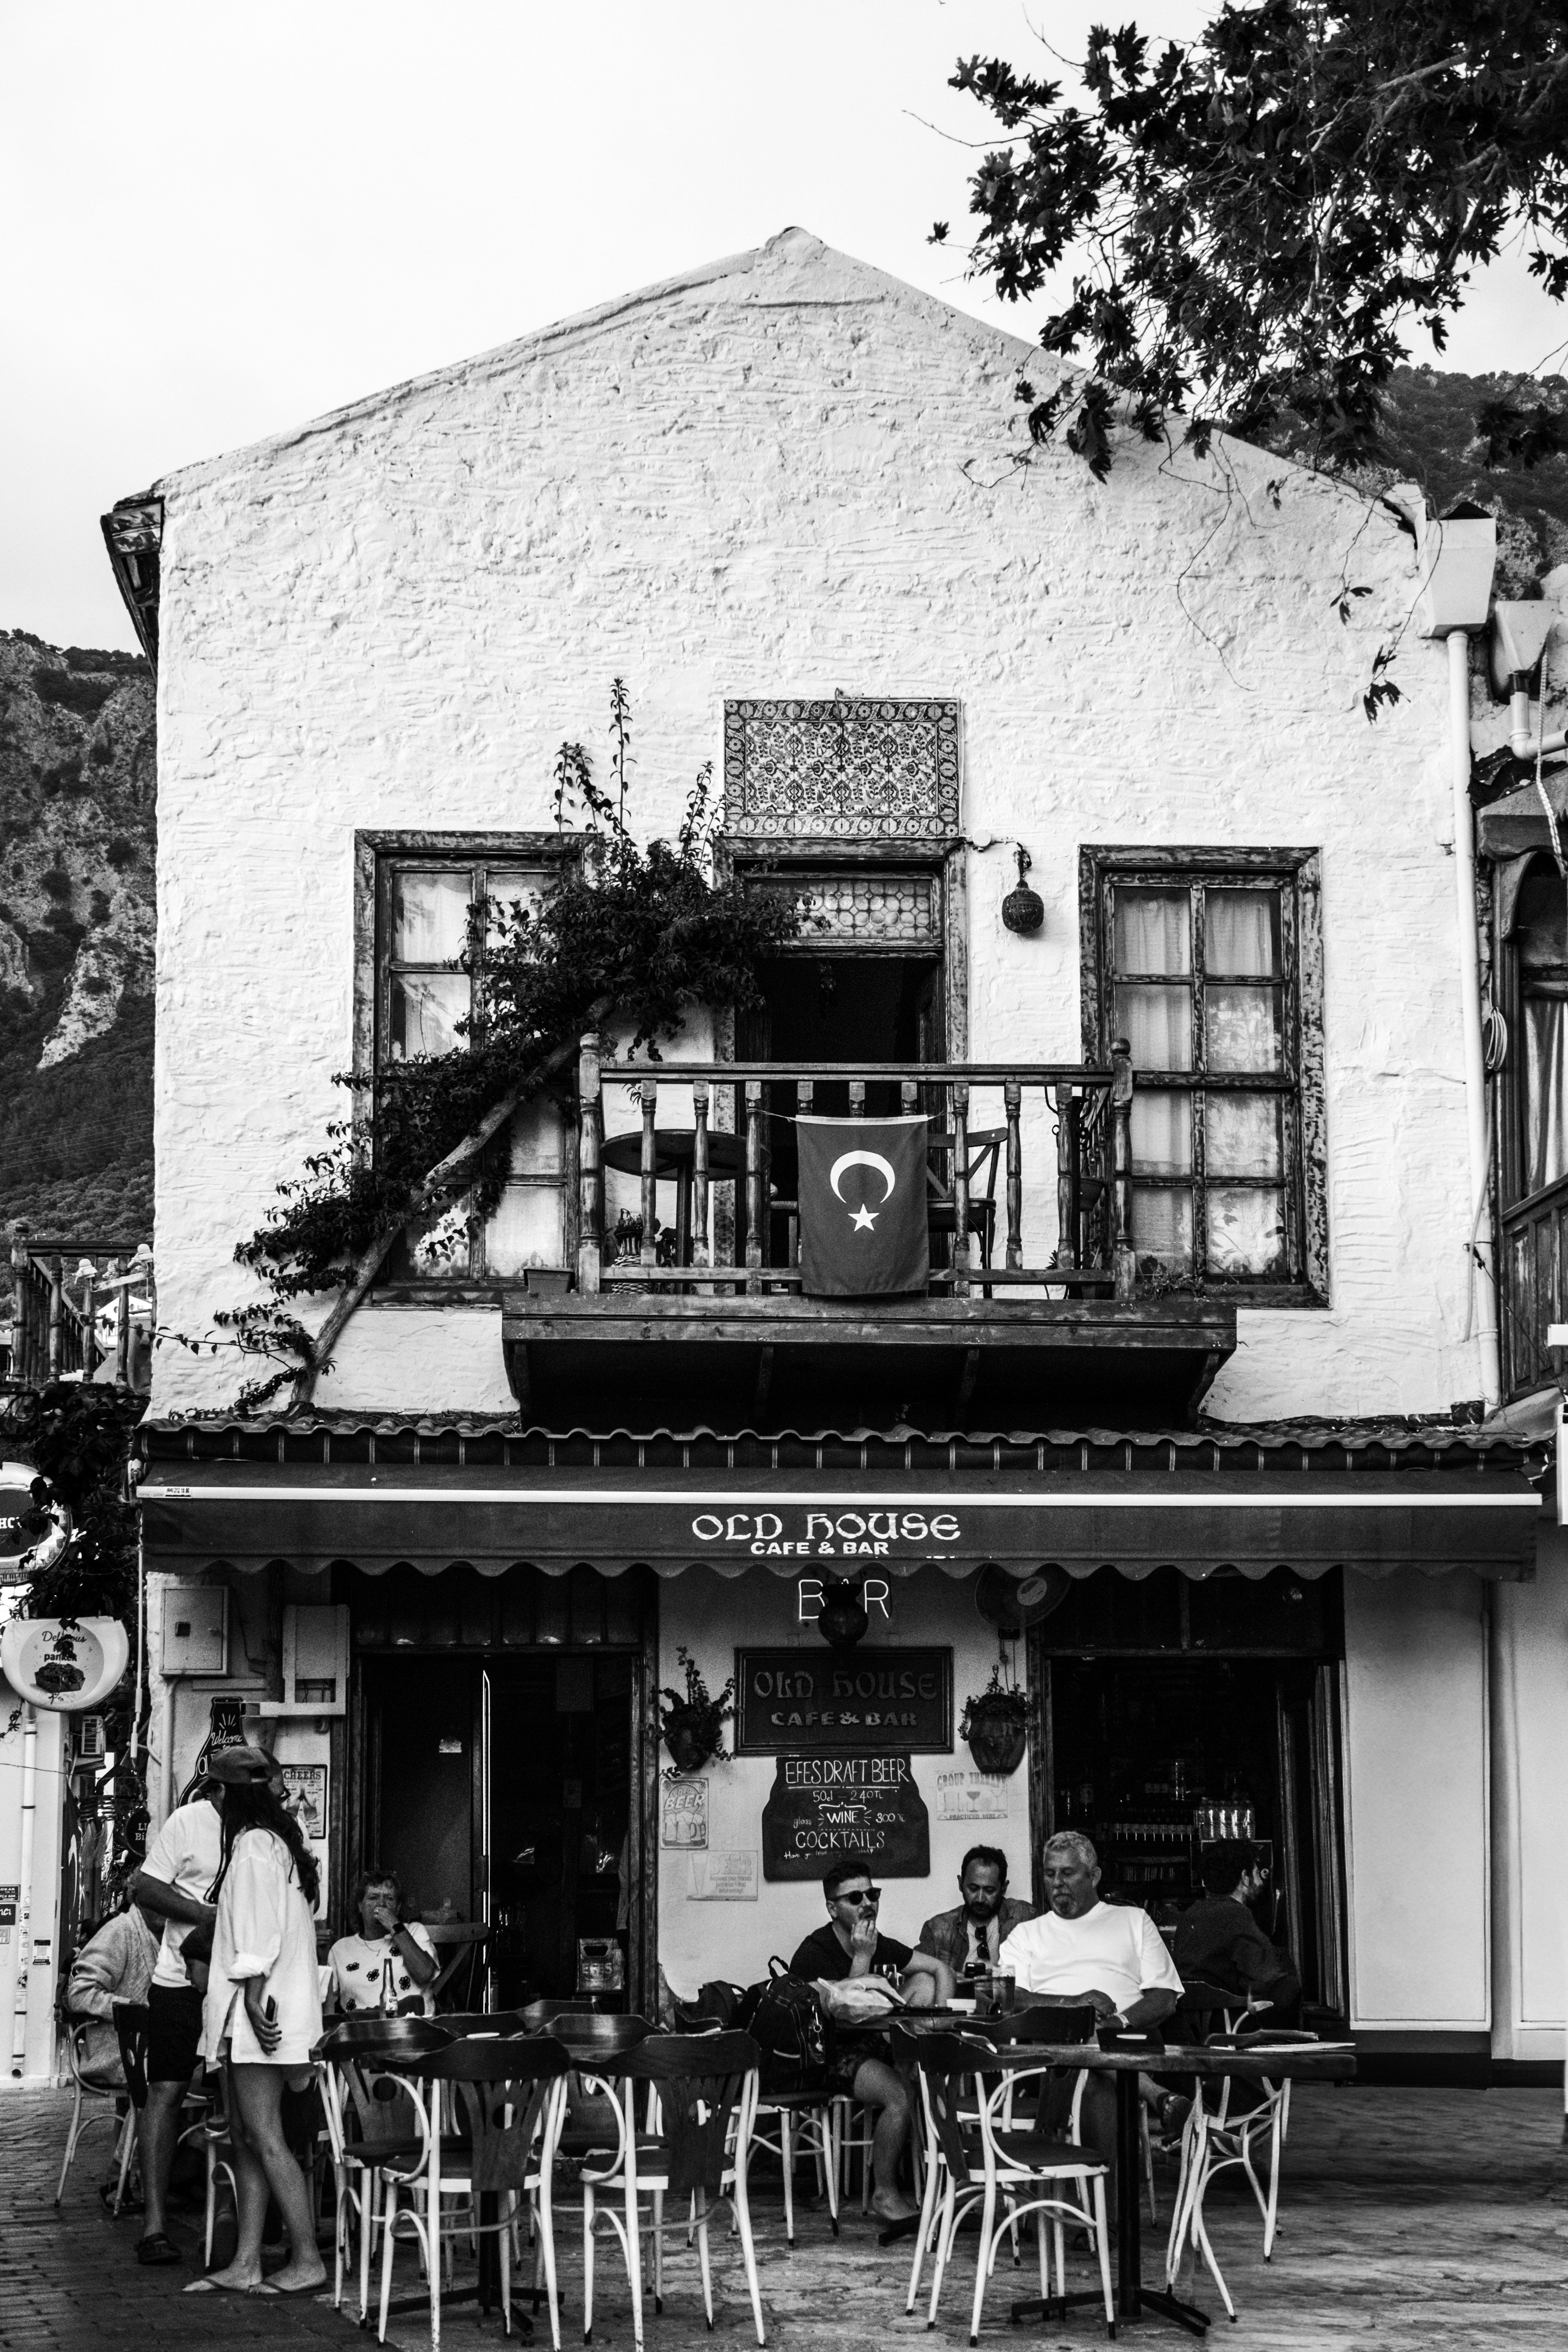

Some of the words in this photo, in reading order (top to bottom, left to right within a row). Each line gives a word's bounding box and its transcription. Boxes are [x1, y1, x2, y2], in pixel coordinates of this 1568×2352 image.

[692, 1513, 782, 1540] OLD
[805, 1513, 961, 1540] HOUSE
[750, 1542, 810, 1555] CAFE
[818, 1541, 835, 1554] &
[843, 1542, 889, 1555] BAR
[798, 1579, 889, 1620] BR
[754, 1671, 813, 1698] OLD
[833, 1671, 937, 1700] HOUSE
[771, 1712, 835, 1726] CAFE
[839, 1712, 860, 1725] &
[865, 1712, 917, 1726] BAR
[211, 1730, 243, 1746] Welcome
[283, 1771, 322, 1779] CHEERS
[785, 1760, 821, 1784] EFES
[824, 1759, 868, 1784] DRAFT
[871, 1758, 910, 1782] BEER
[663, 1793, 706, 1811] BEER
[827, 1810, 859, 1824] WINE
[875, 1812, 896, 1824] 300
[796, 1831, 885, 1848] COCKTAILS
